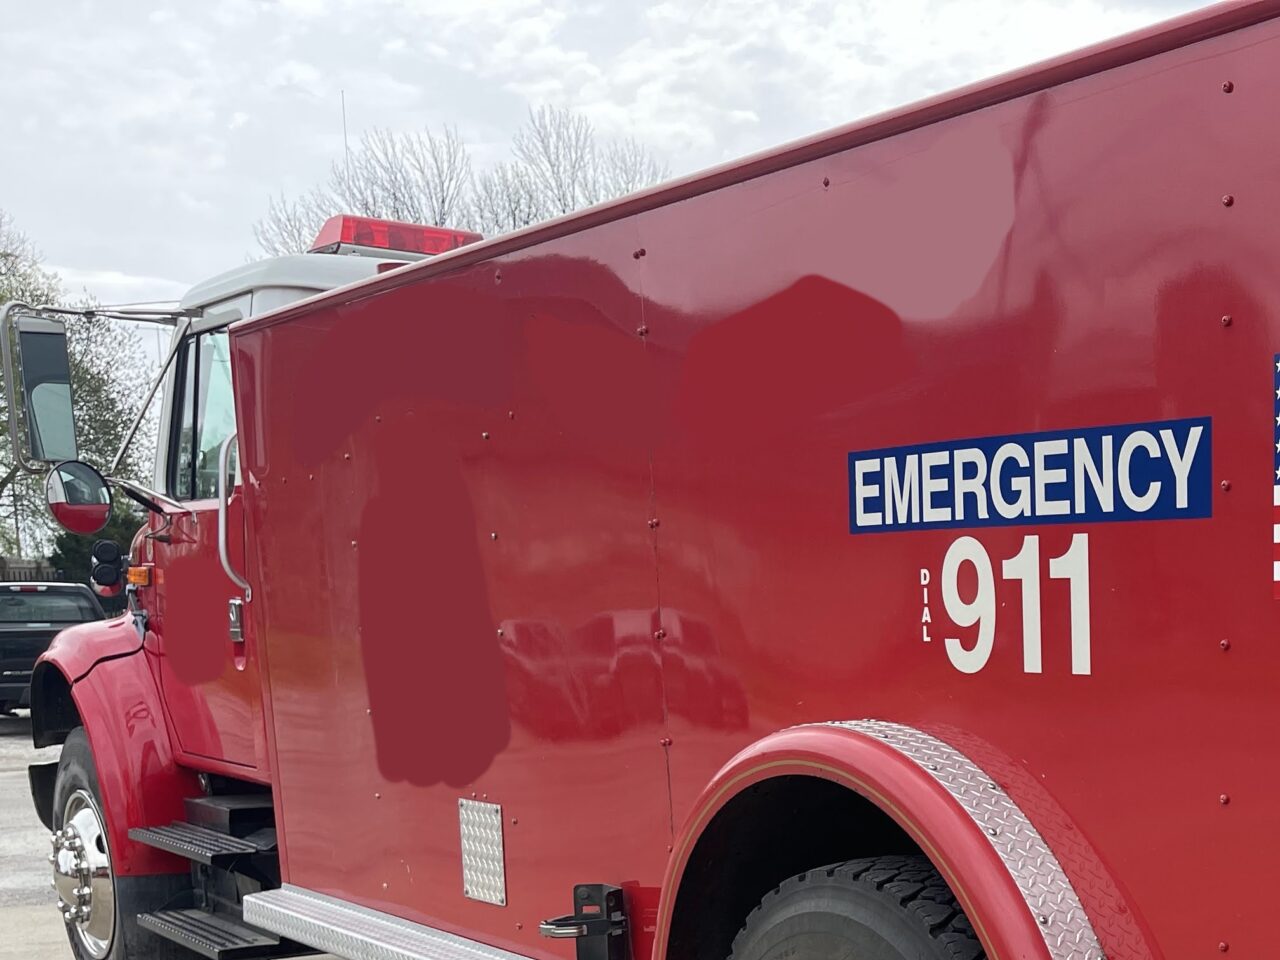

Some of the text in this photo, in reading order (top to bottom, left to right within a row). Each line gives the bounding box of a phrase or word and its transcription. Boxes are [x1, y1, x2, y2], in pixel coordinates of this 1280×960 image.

[854, 426, 1204, 527] EMERGENCY
[920, 568, 931, 642] DIAL
[941, 532, 1092, 676] 911
